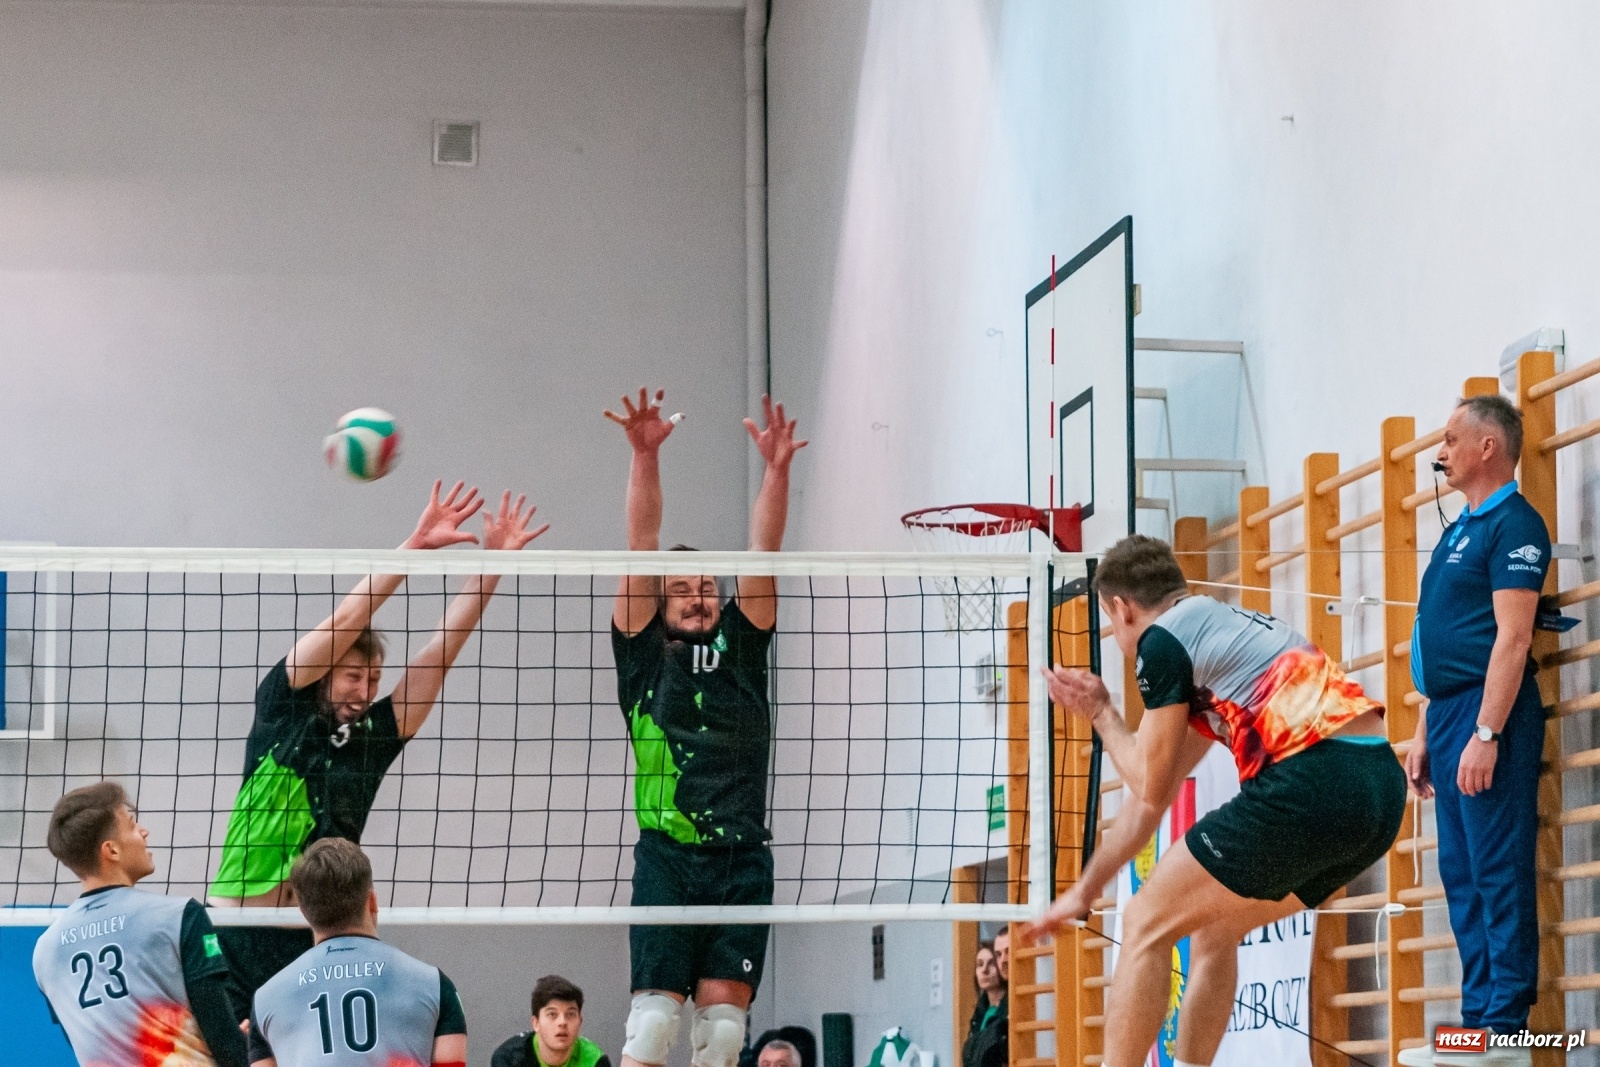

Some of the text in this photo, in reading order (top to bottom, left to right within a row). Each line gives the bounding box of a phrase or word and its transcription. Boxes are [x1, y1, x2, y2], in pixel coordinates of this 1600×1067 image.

[692, 644, 720, 673] 10
[60, 914, 126, 946] KS VOLLEY
[69, 942, 130, 1010] 23
[298, 961, 385, 987] KS VOLLEY
[308, 986, 379, 1056] 10
